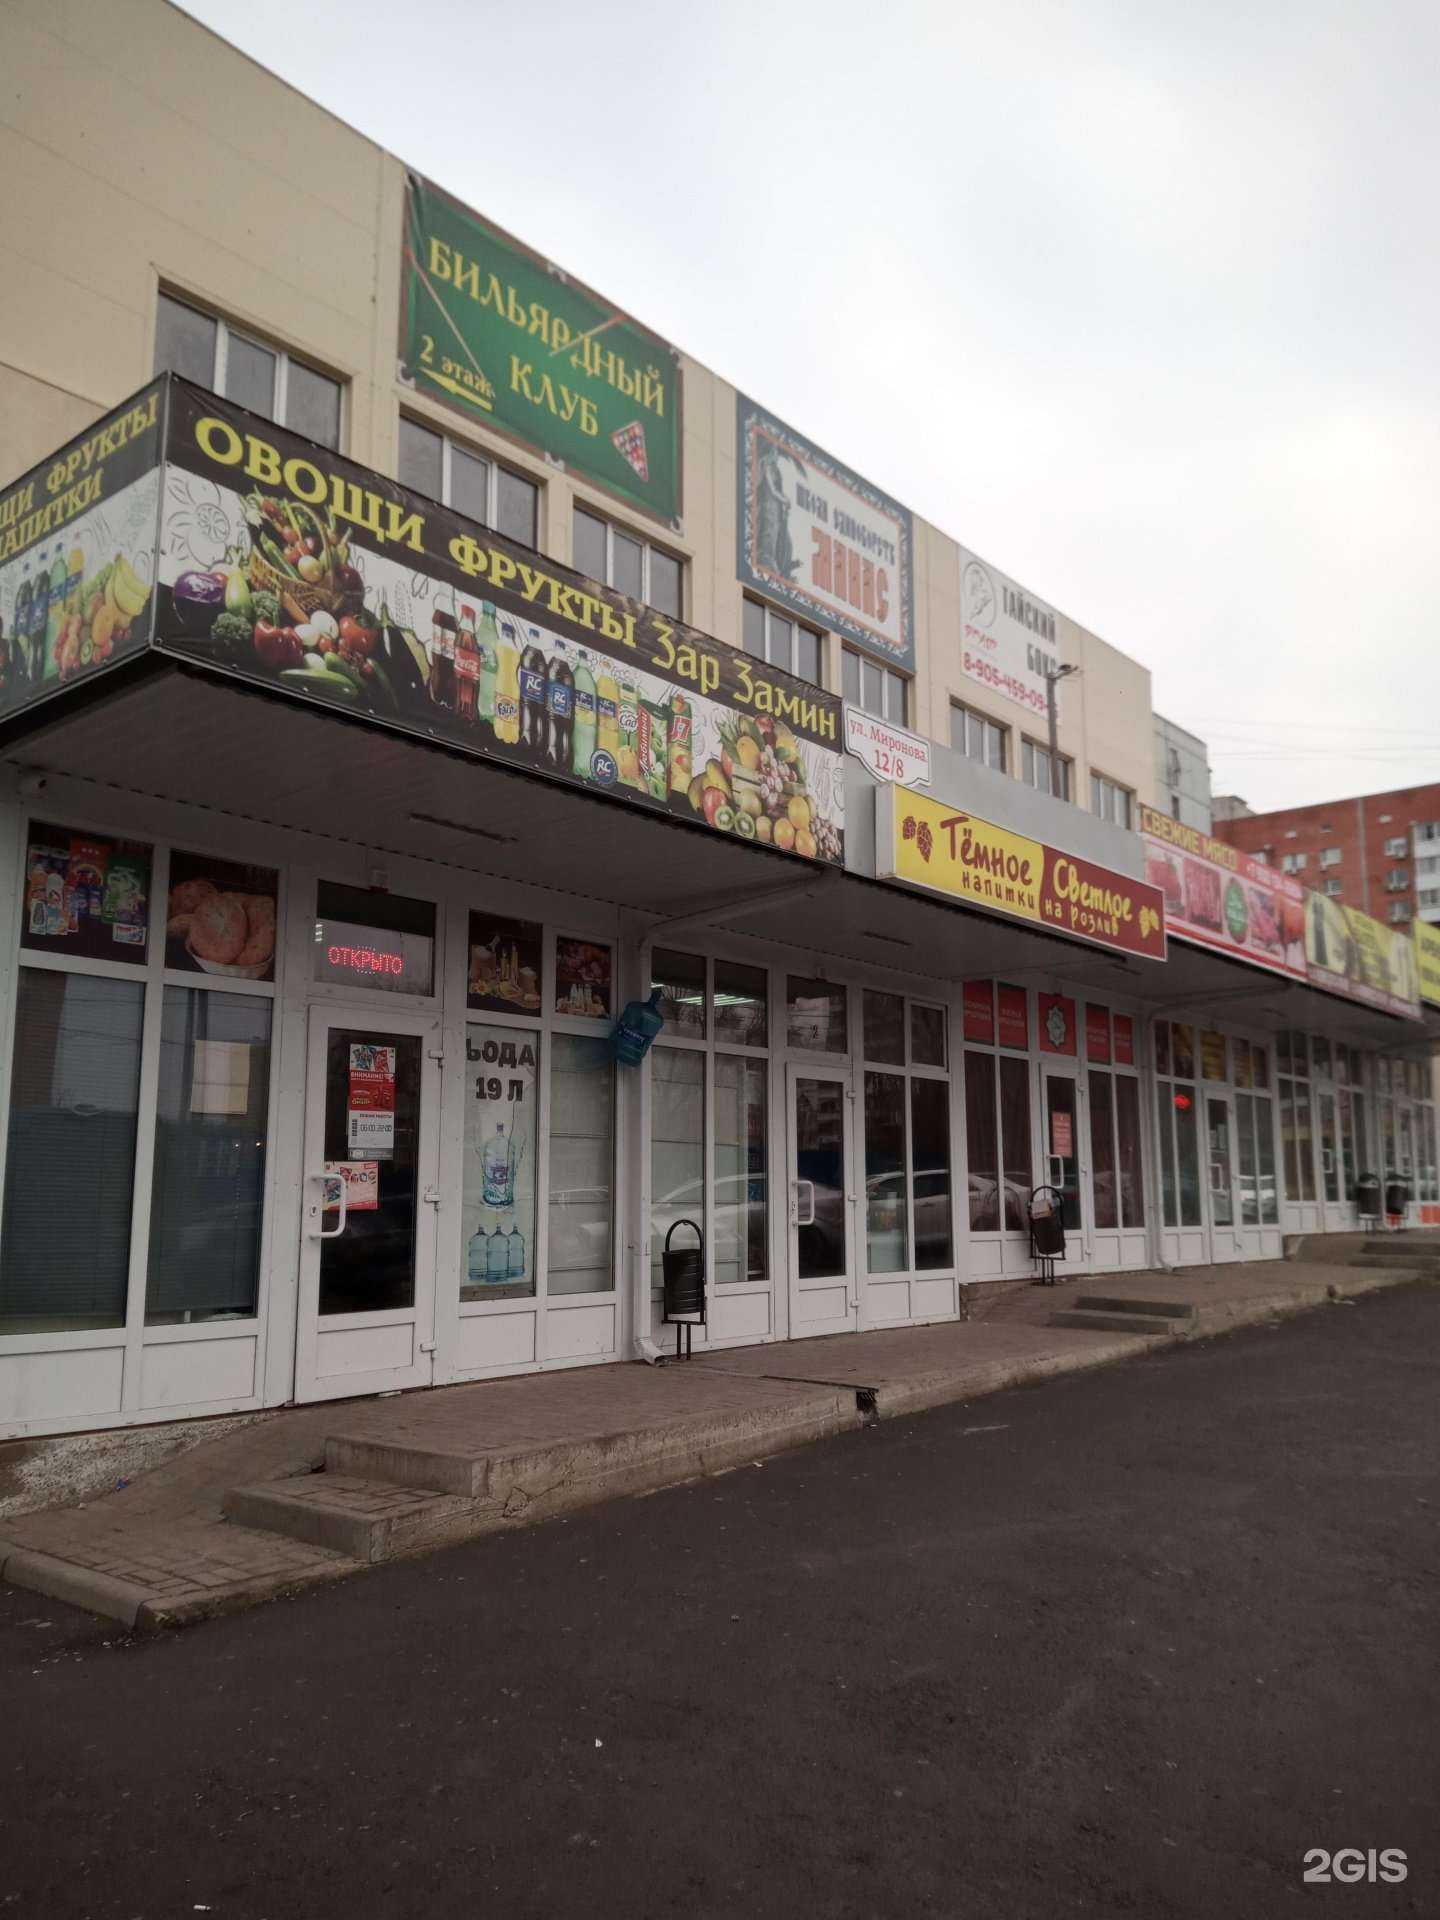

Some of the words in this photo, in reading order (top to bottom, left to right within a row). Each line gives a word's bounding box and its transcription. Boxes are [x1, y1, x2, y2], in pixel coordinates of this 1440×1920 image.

[429, 237, 665, 417] БИЛЬЯРДНЫЙ
[420, 334, 433, 365] 2
[510, 355, 599, 437] КЛУБ
[47, 392, 157, 494] ФРУКТЫ
[195, 417, 425, 553] ОВОЩИ
[448, 533, 637, 648] ФРУКТЫ
[651, 620, 720, 696] Зар
[733, 659, 837, 741] Замин
[1003, 586, 1055, 645] ТАЙСКИЙ
[526, 675, 542, 691] RC
[553, 691, 566, 705] RC
[849, 720, 868, 738] ул.
[597, 758, 612, 774] RC
[874, 749, 904, 778] 12/8
[940, 816, 1033, 886] Тёмное
[1053, 858, 1133, 922] Светлое
[962, 871, 1035, 910] напитки
[1045, 899, 1063, 918] на
[1071, 904, 1120, 937] розлив
[328, 946, 403, 974] ОТКРЫТО
[476, 1077, 502, 1100] 19
